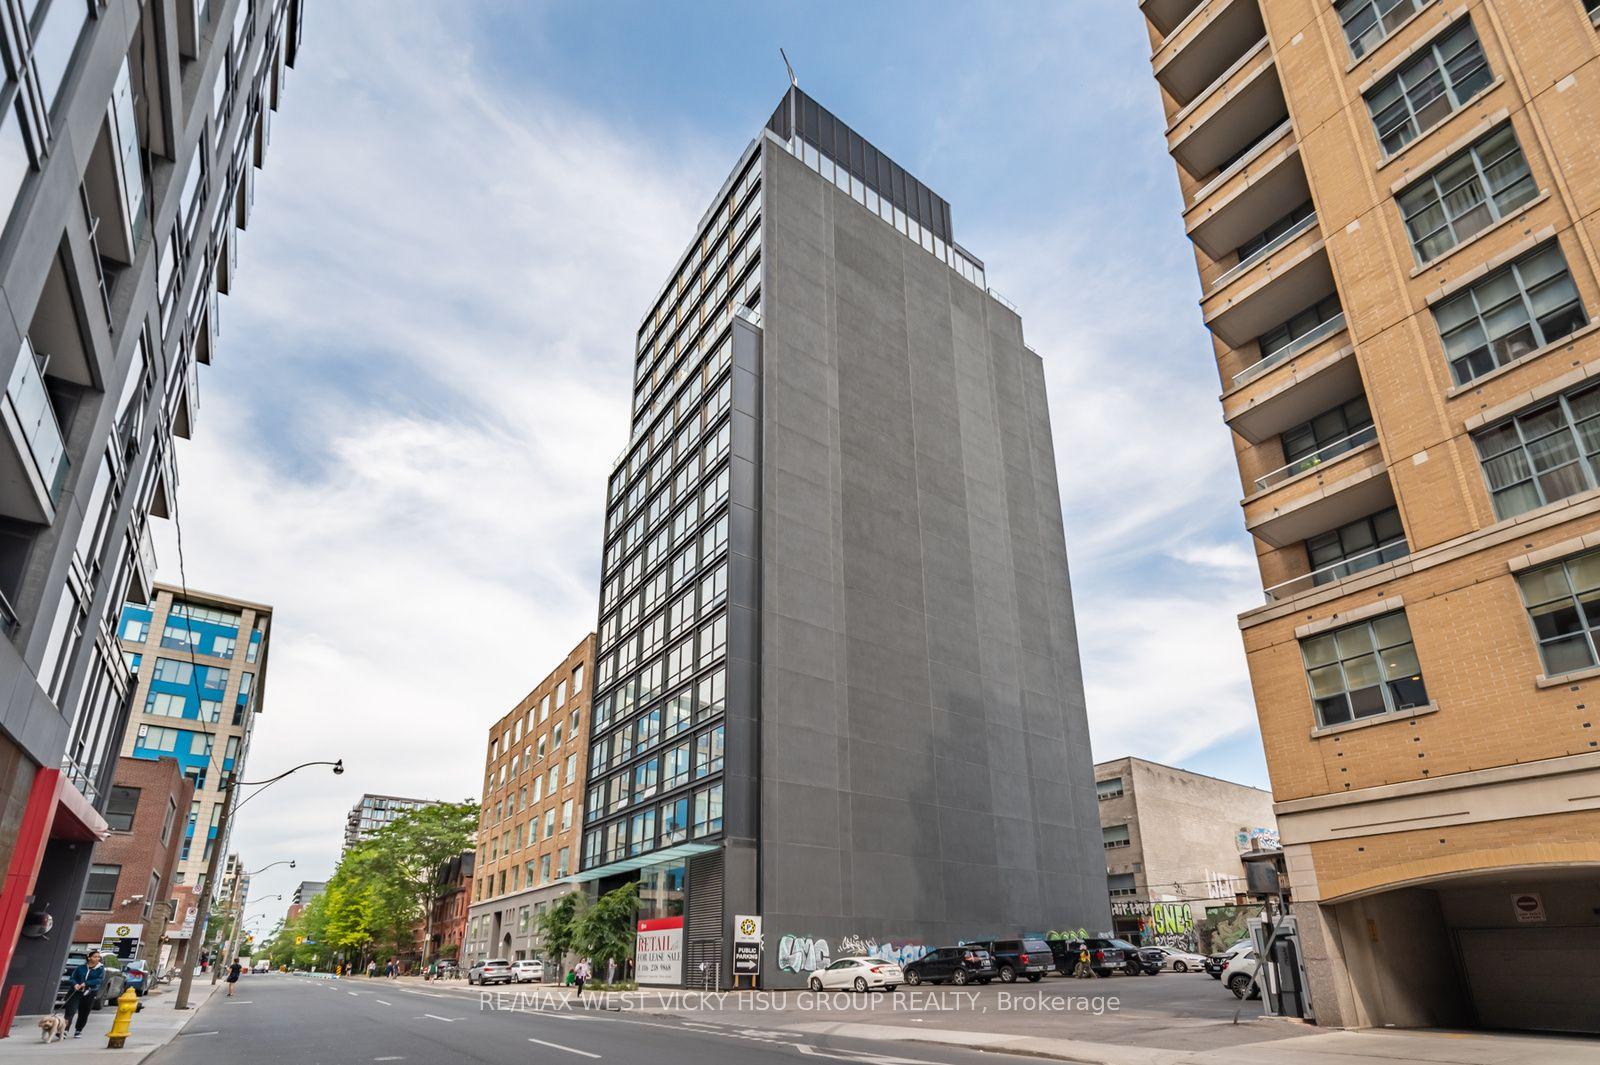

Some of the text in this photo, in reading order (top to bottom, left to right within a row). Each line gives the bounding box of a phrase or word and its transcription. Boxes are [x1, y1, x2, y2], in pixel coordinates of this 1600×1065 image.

[638, 935, 672, 952] RETAIL
[637, 951, 680, 962] FOR LEASE SALE
